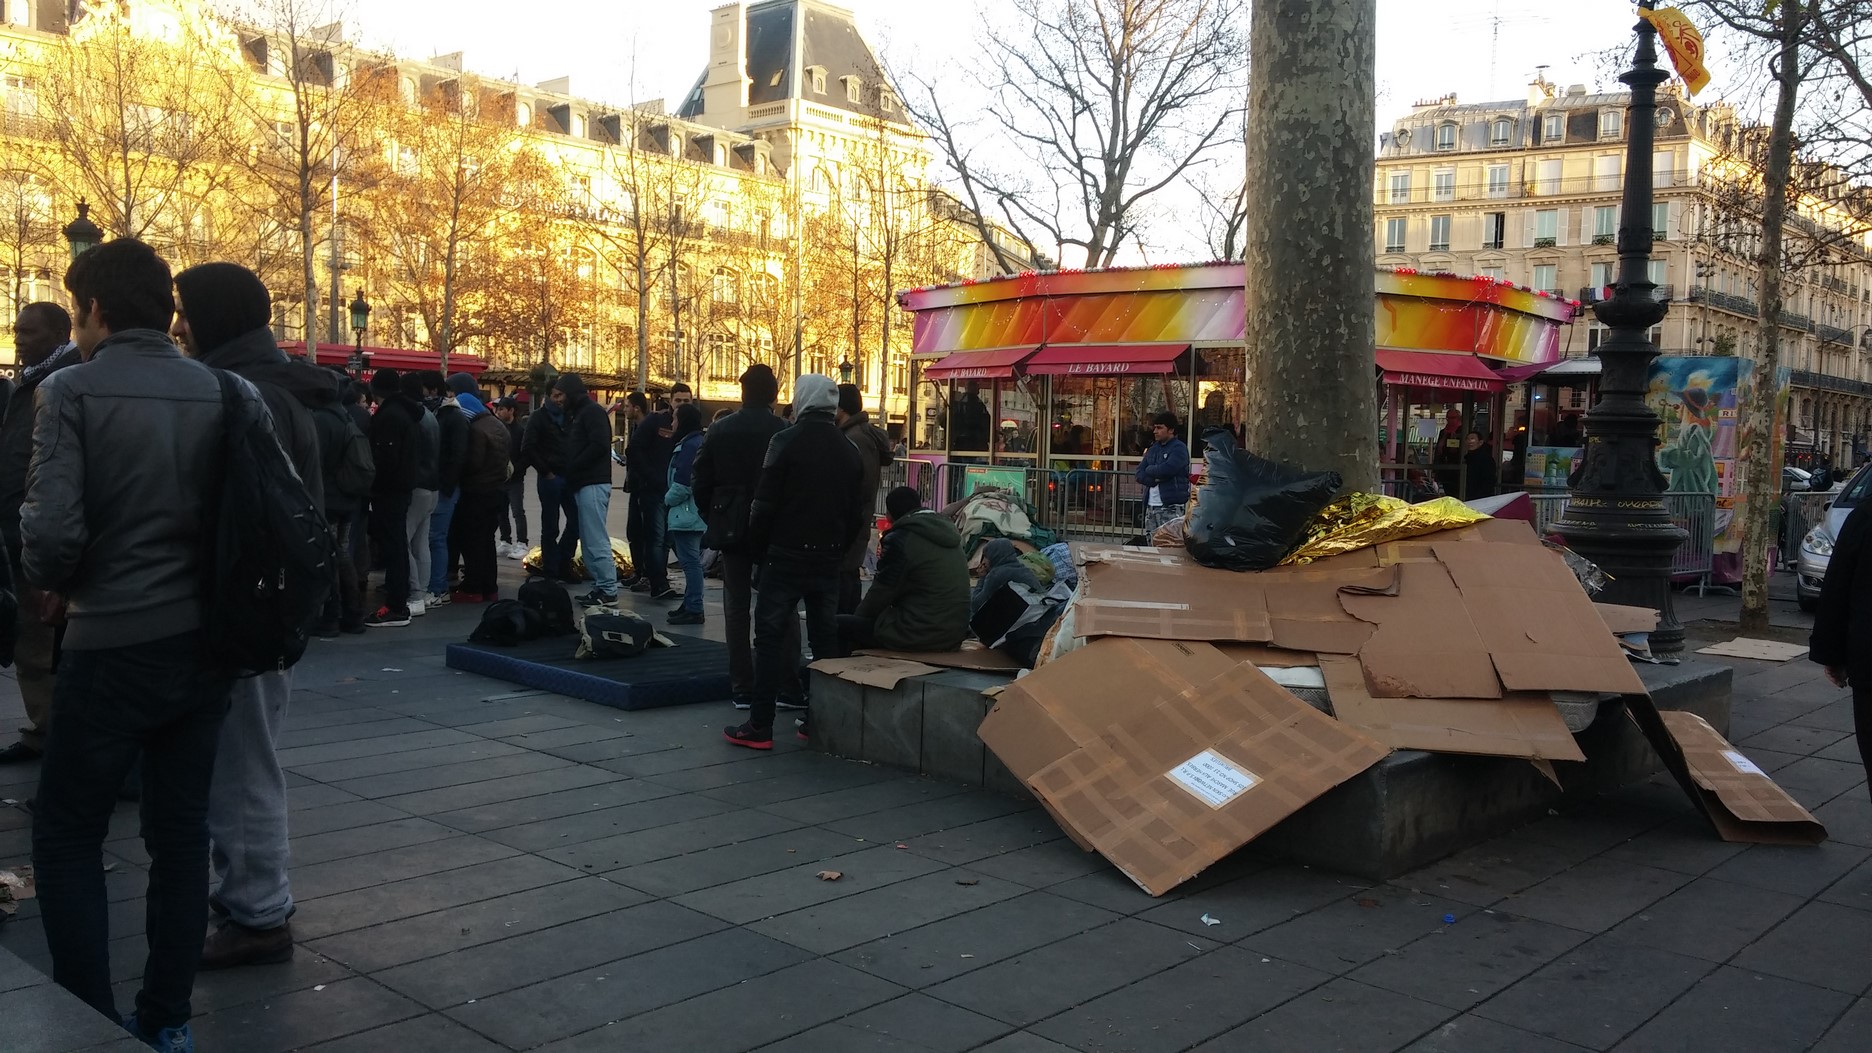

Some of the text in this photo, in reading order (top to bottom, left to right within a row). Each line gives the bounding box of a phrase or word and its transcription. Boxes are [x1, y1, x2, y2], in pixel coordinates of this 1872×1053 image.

[960, 368, 987, 377] BAYARD
[1068, 362, 1130, 373] LE BAYARD
[1443, 378, 1489, 390] ENFANTIN
